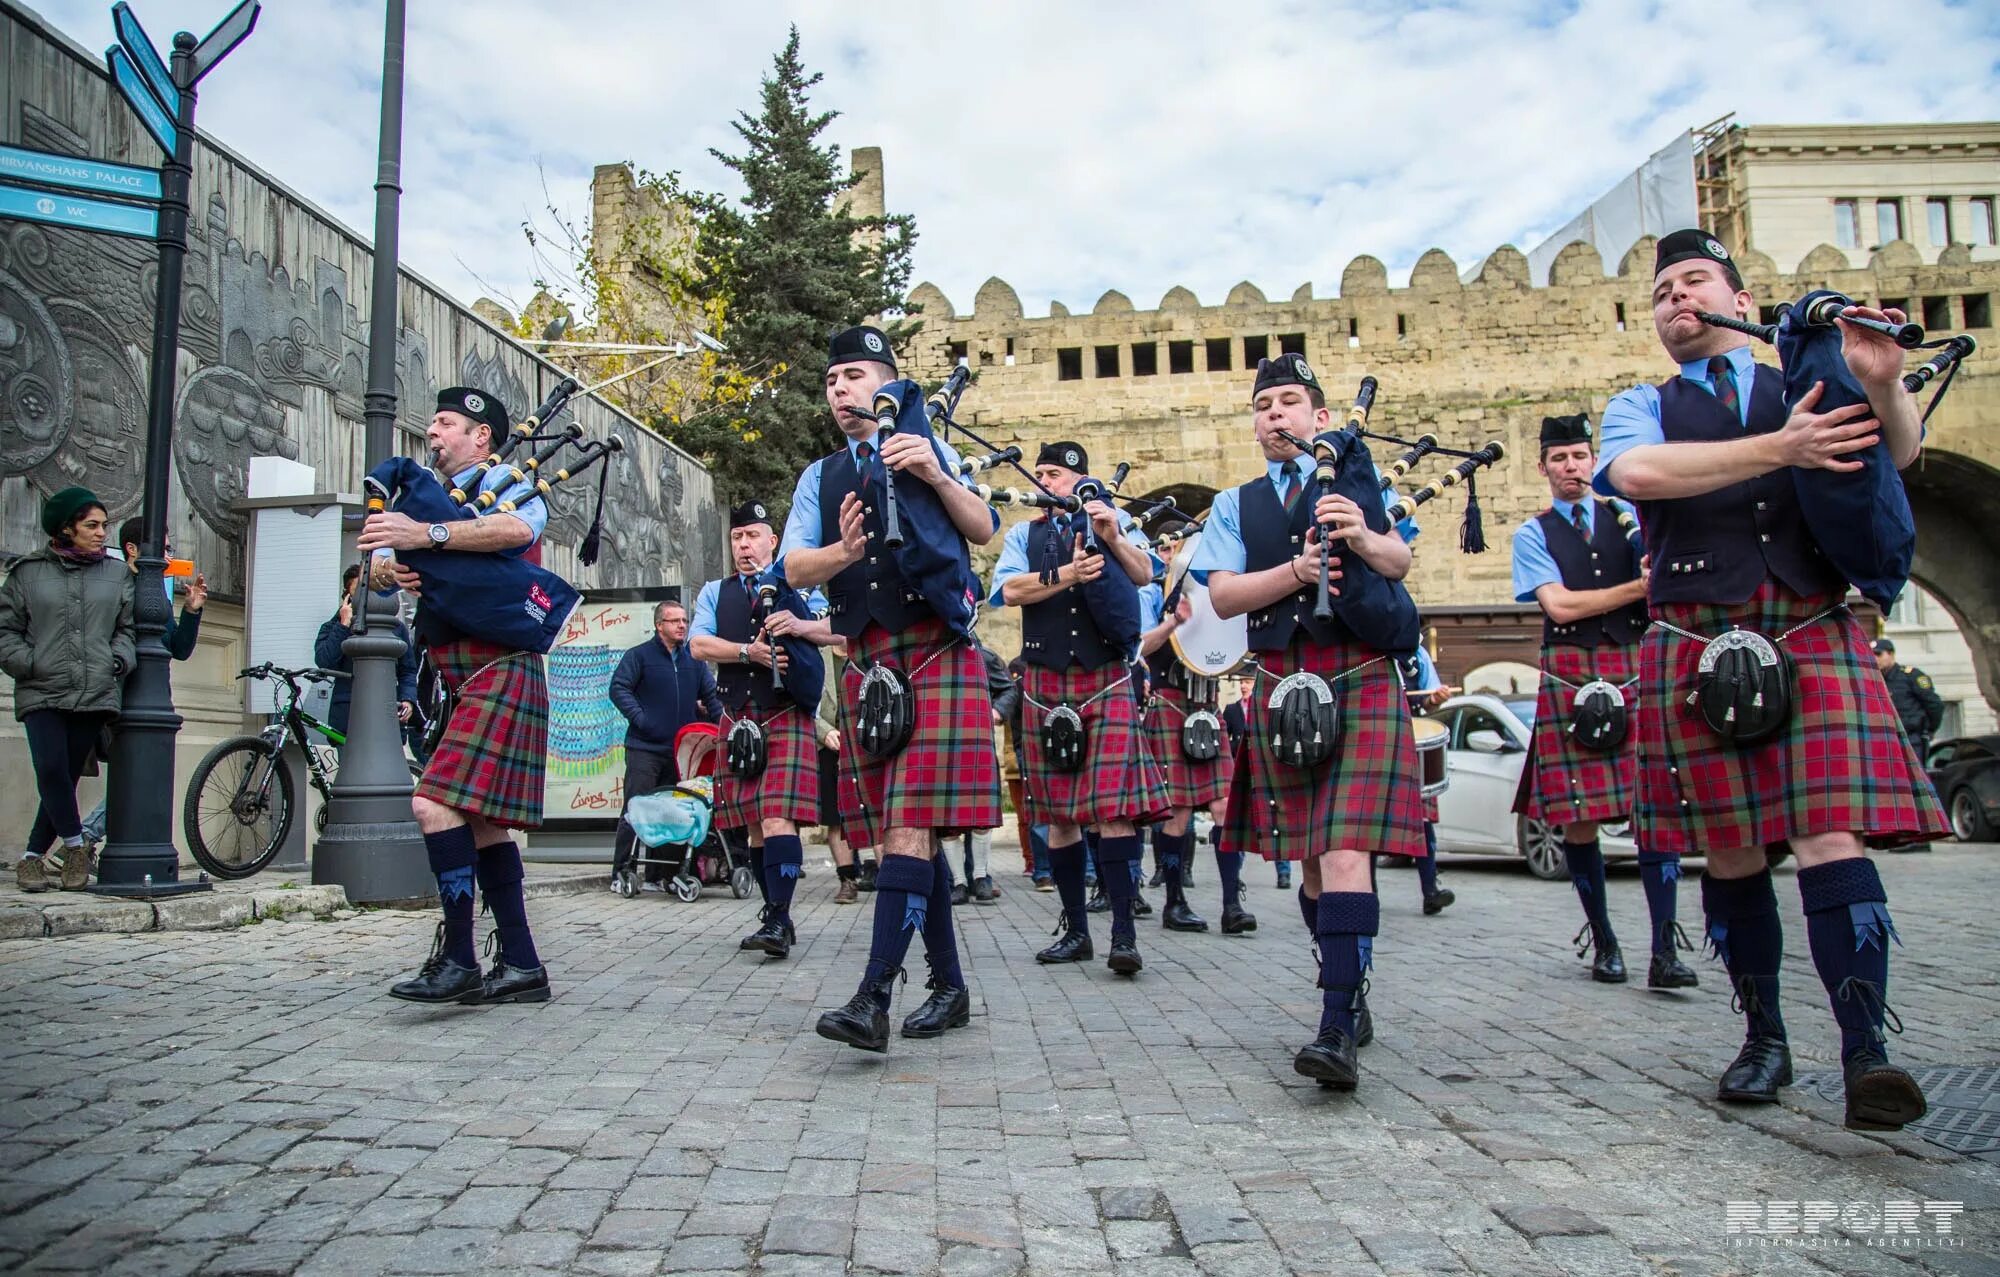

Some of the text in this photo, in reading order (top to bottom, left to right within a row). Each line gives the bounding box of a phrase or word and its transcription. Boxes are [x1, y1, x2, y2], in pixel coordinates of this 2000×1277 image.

[96, 171, 143, 188] PALACE
[66, 205, 88, 218] WC
[571, 786, 608, 809] Living
